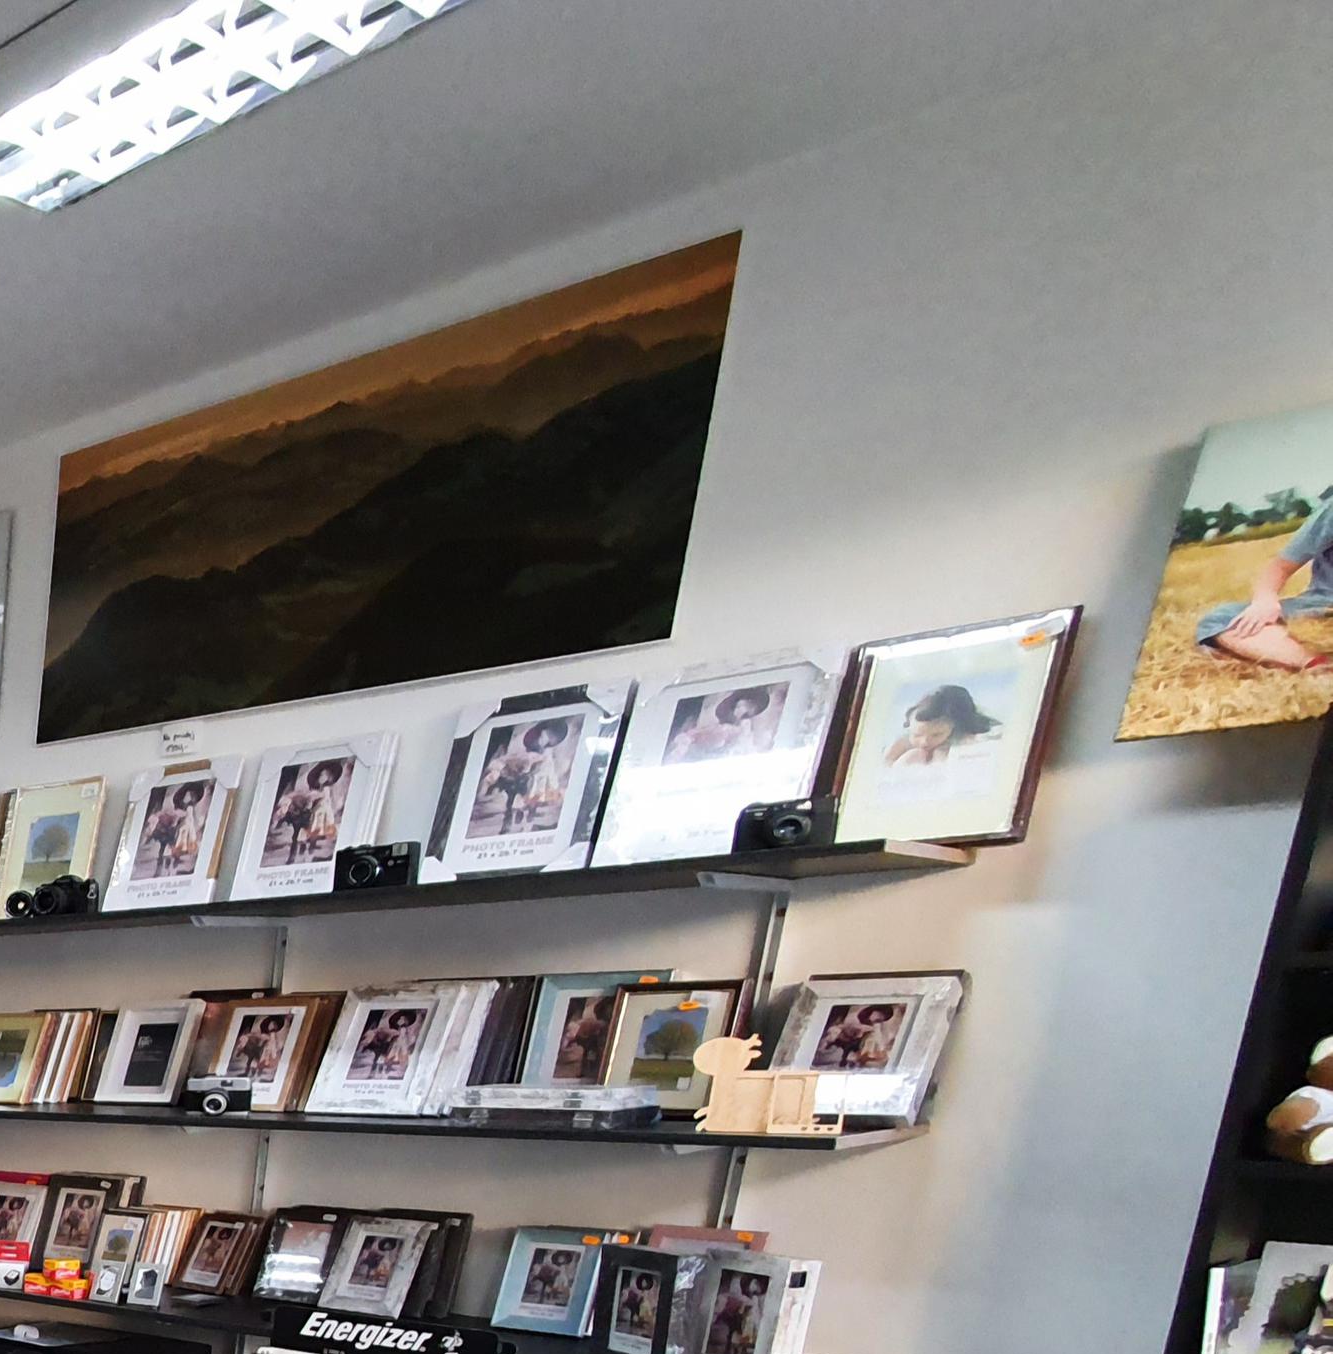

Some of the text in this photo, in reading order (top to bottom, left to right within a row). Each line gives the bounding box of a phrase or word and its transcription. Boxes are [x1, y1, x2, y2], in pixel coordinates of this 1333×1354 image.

[462, 834, 555, 853] PHOTO FRAME
[255, 866, 330, 882] PHOTO FRAME
[127, 879, 192, 894] PHOTO FRAME
[299, 1311, 432, 1352] Energizer
